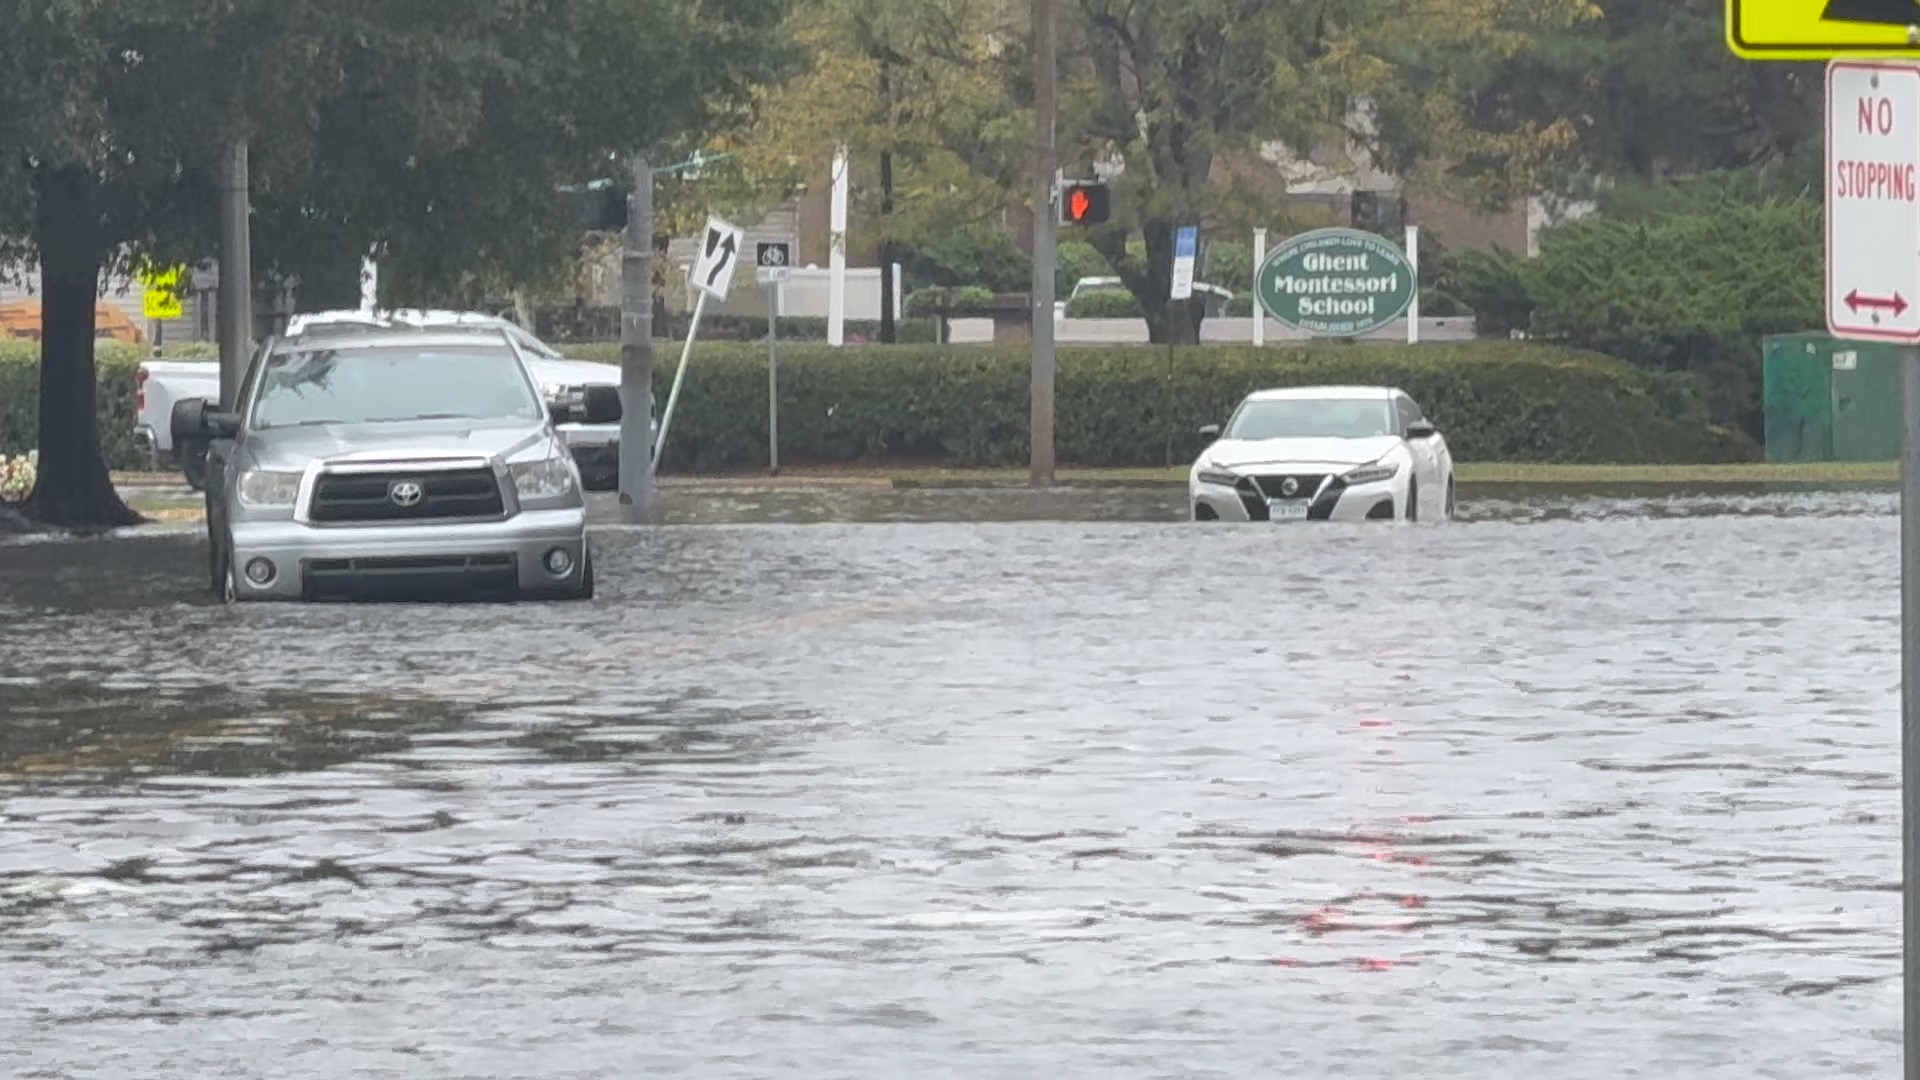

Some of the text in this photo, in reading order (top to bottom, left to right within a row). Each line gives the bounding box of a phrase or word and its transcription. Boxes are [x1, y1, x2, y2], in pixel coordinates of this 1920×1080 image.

[1858, 96, 1892, 135] NO
[1837, 159, 1915, 201] STOPPING
[1303, 252, 1369, 272] Ghent
[1274, 272, 1397, 294] Montessori
[1298, 296, 1374, 316] School
